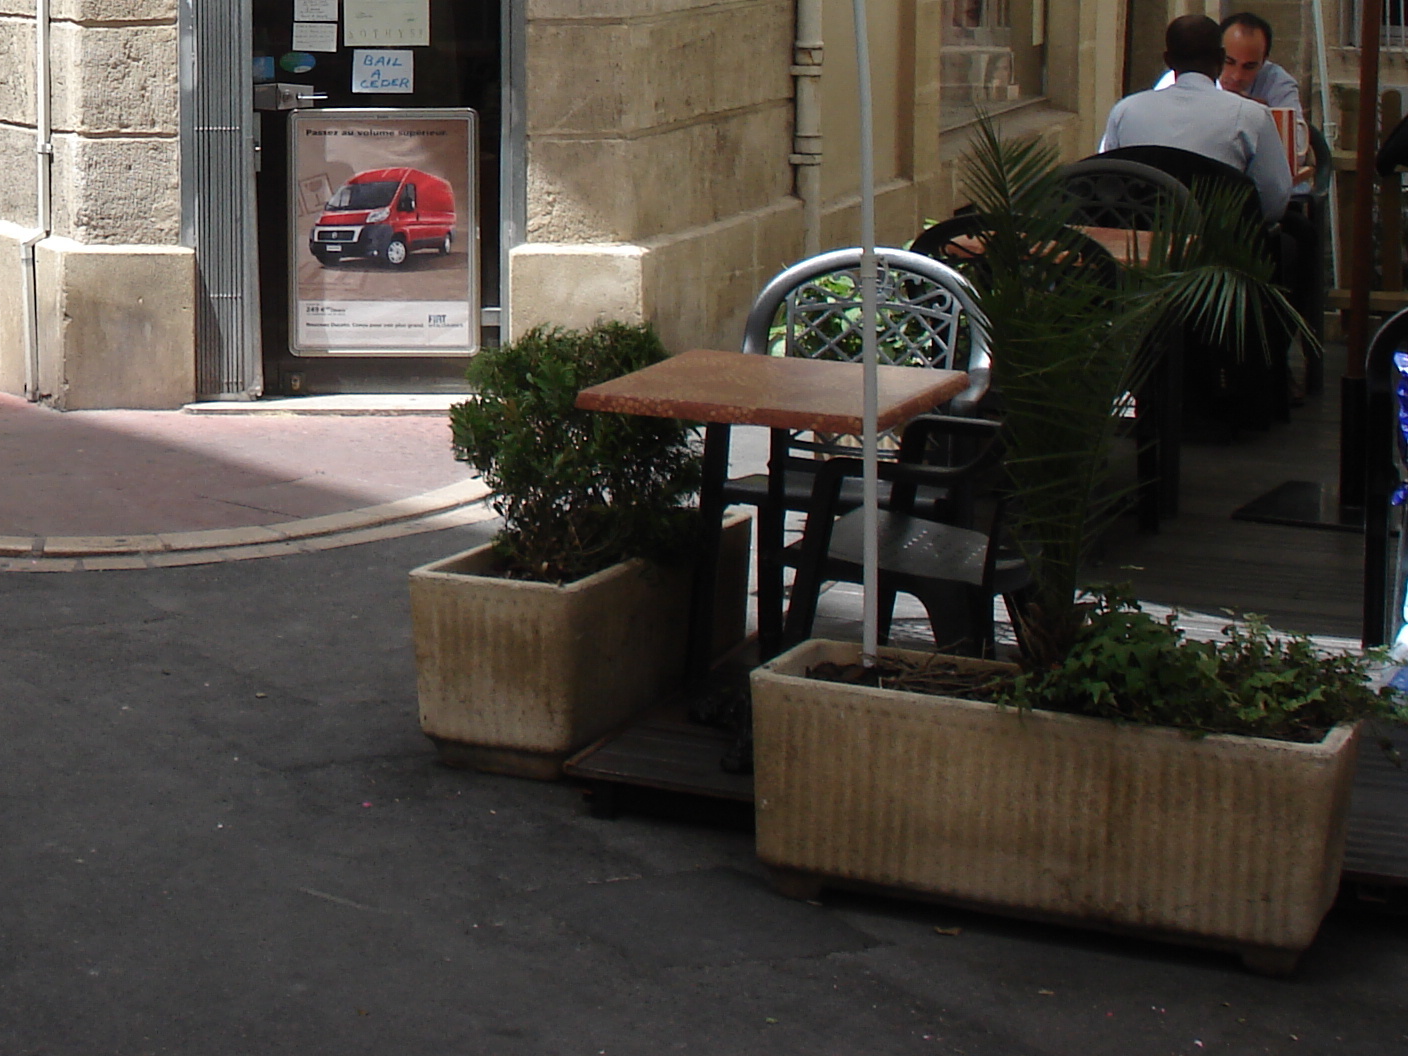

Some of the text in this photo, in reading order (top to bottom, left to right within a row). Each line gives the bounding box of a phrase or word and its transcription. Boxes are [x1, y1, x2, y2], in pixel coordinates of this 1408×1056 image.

[363, 54, 403, 67] BAIL
[370, 68, 382, 80] A
[360, 77, 410, 89] CEDER
[357, 128, 395, 137] volume
